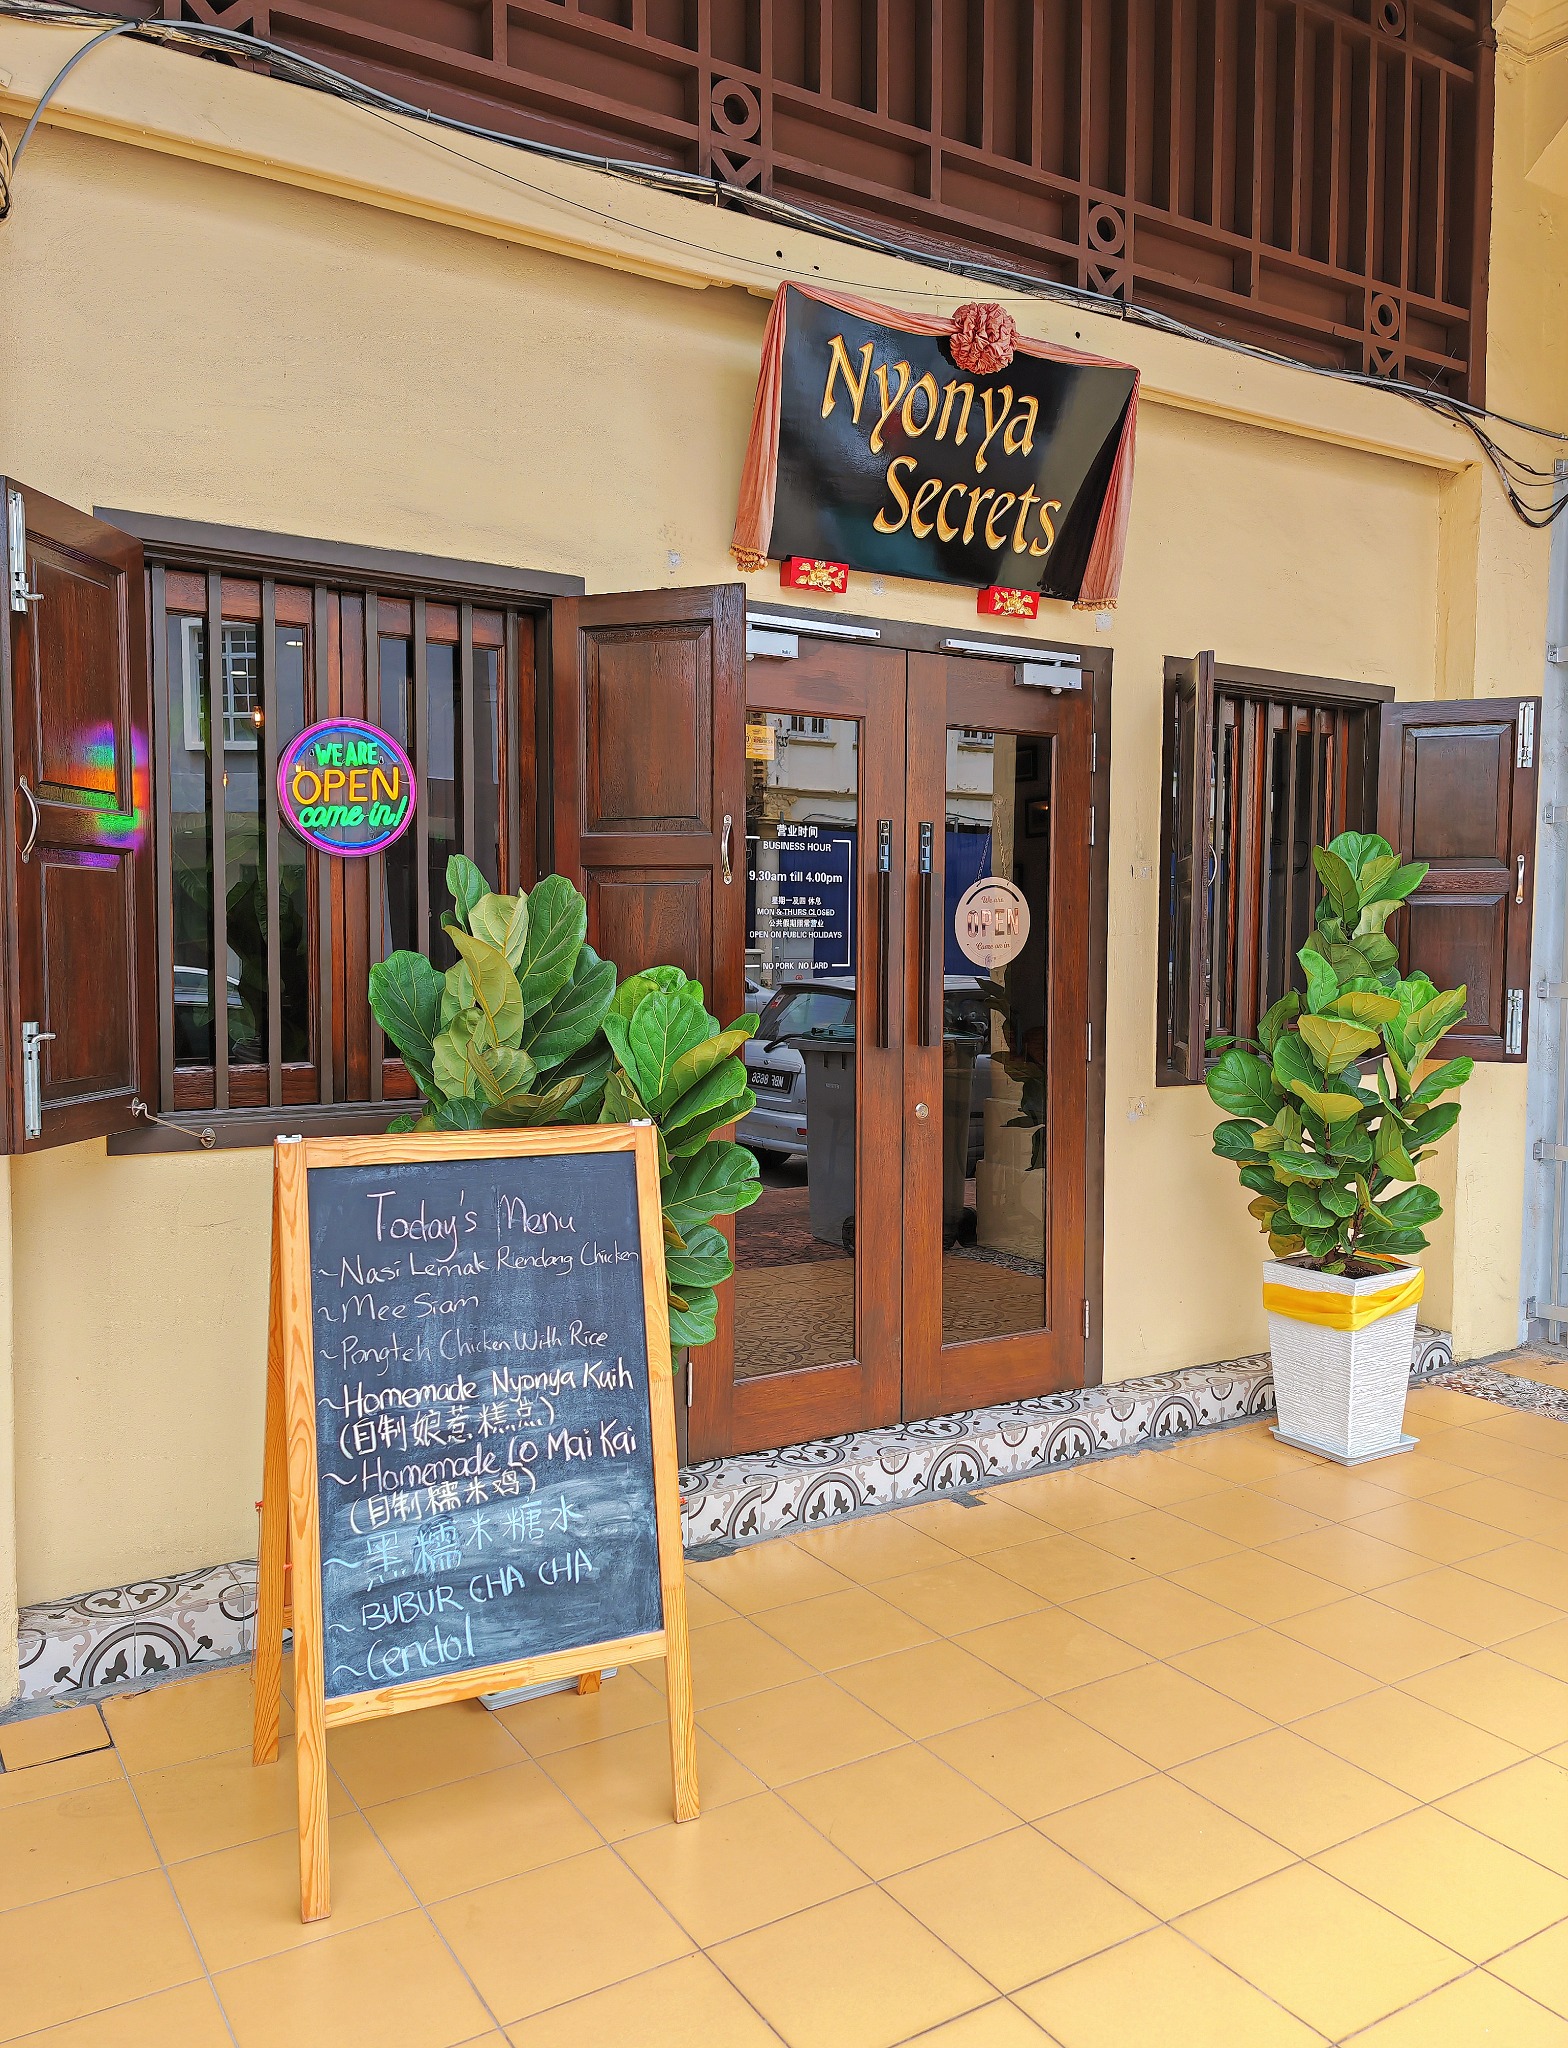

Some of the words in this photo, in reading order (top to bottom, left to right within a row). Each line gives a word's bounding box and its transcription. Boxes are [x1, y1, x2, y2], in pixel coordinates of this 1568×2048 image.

[821, 333, 1040, 474] Nyonya
[872, 455, 1062, 557] Secrets
[314, 742, 343, 767] WE
[345, 741, 379, 766] ARE
[292, 767, 400, 805] OPEN
[299, 804, 365, 827] come
[368, 795, 408, 827] in!
[763, 841, 806, 851] BUSINESS
[807, 842, 832, 852] HOUR
[776, 824, 819, 838] 营业时间
[749, 871, 787, 882] 9.30am
[789, 871, 803, 883] till
[805, 872, 843, 885] 4.00pm
[757, 908, 775, 916] MON
[783, 908, 807, 917] THURS
[808, 909, 835, 917] CLOSED
[981, 895, 993, 903] We
[749, 930, 769, 938] OPEN
[770, 931, 781, 939] ON
[783, 931, 807, 939] PUBLIC
[808, 931, 843, 939] HOLIDAYS
[967, 908, 1019, 938] OPEN
[975, 941, 994, 950] Come
[762, 962, 774, 970] NO
[775, 962, 794, 970] PORK
[798, 962, 810, 970] NO
[810, 962, 829, 970] LARD
[367, 1189, 478, 1262] Today's
[497, 1193, 577, 1241] Menu
[340, 1254, 402, 1288] Nasi
[409, 1251, 490, 1277] Lemak
[496, 1245, 574, 1276] Rendang
[580, 1240, 639, 1268] Chicken
[341, 1293, 408, 1323] Mee
[413, 1292, 480, 1318] Siam
[340, 1332, 432, 1377] Pongteh
[439, 1328, 511, 1361] Chicken
[514, 1325, 562, 1352] With
[568, 1319, 609, 1348] Rice
[343, 1373, 480, 1418] Homemade
[491, 1366, 576, 1402] Nyonya
[582, 1357, 635, 1390] Kuih
[361, 1443, 502, 1493] Homemade
[547, 1428, 593, 1462] Mai
[600, 1418, 638, 1459] Kai
[361, 1585, 465, 1632] BUBUR
[468, 1565, 527, 1604] CHA
[538, 1547, 594, 1586] CHA
[366, 1612, 477, 1681] Cendol
